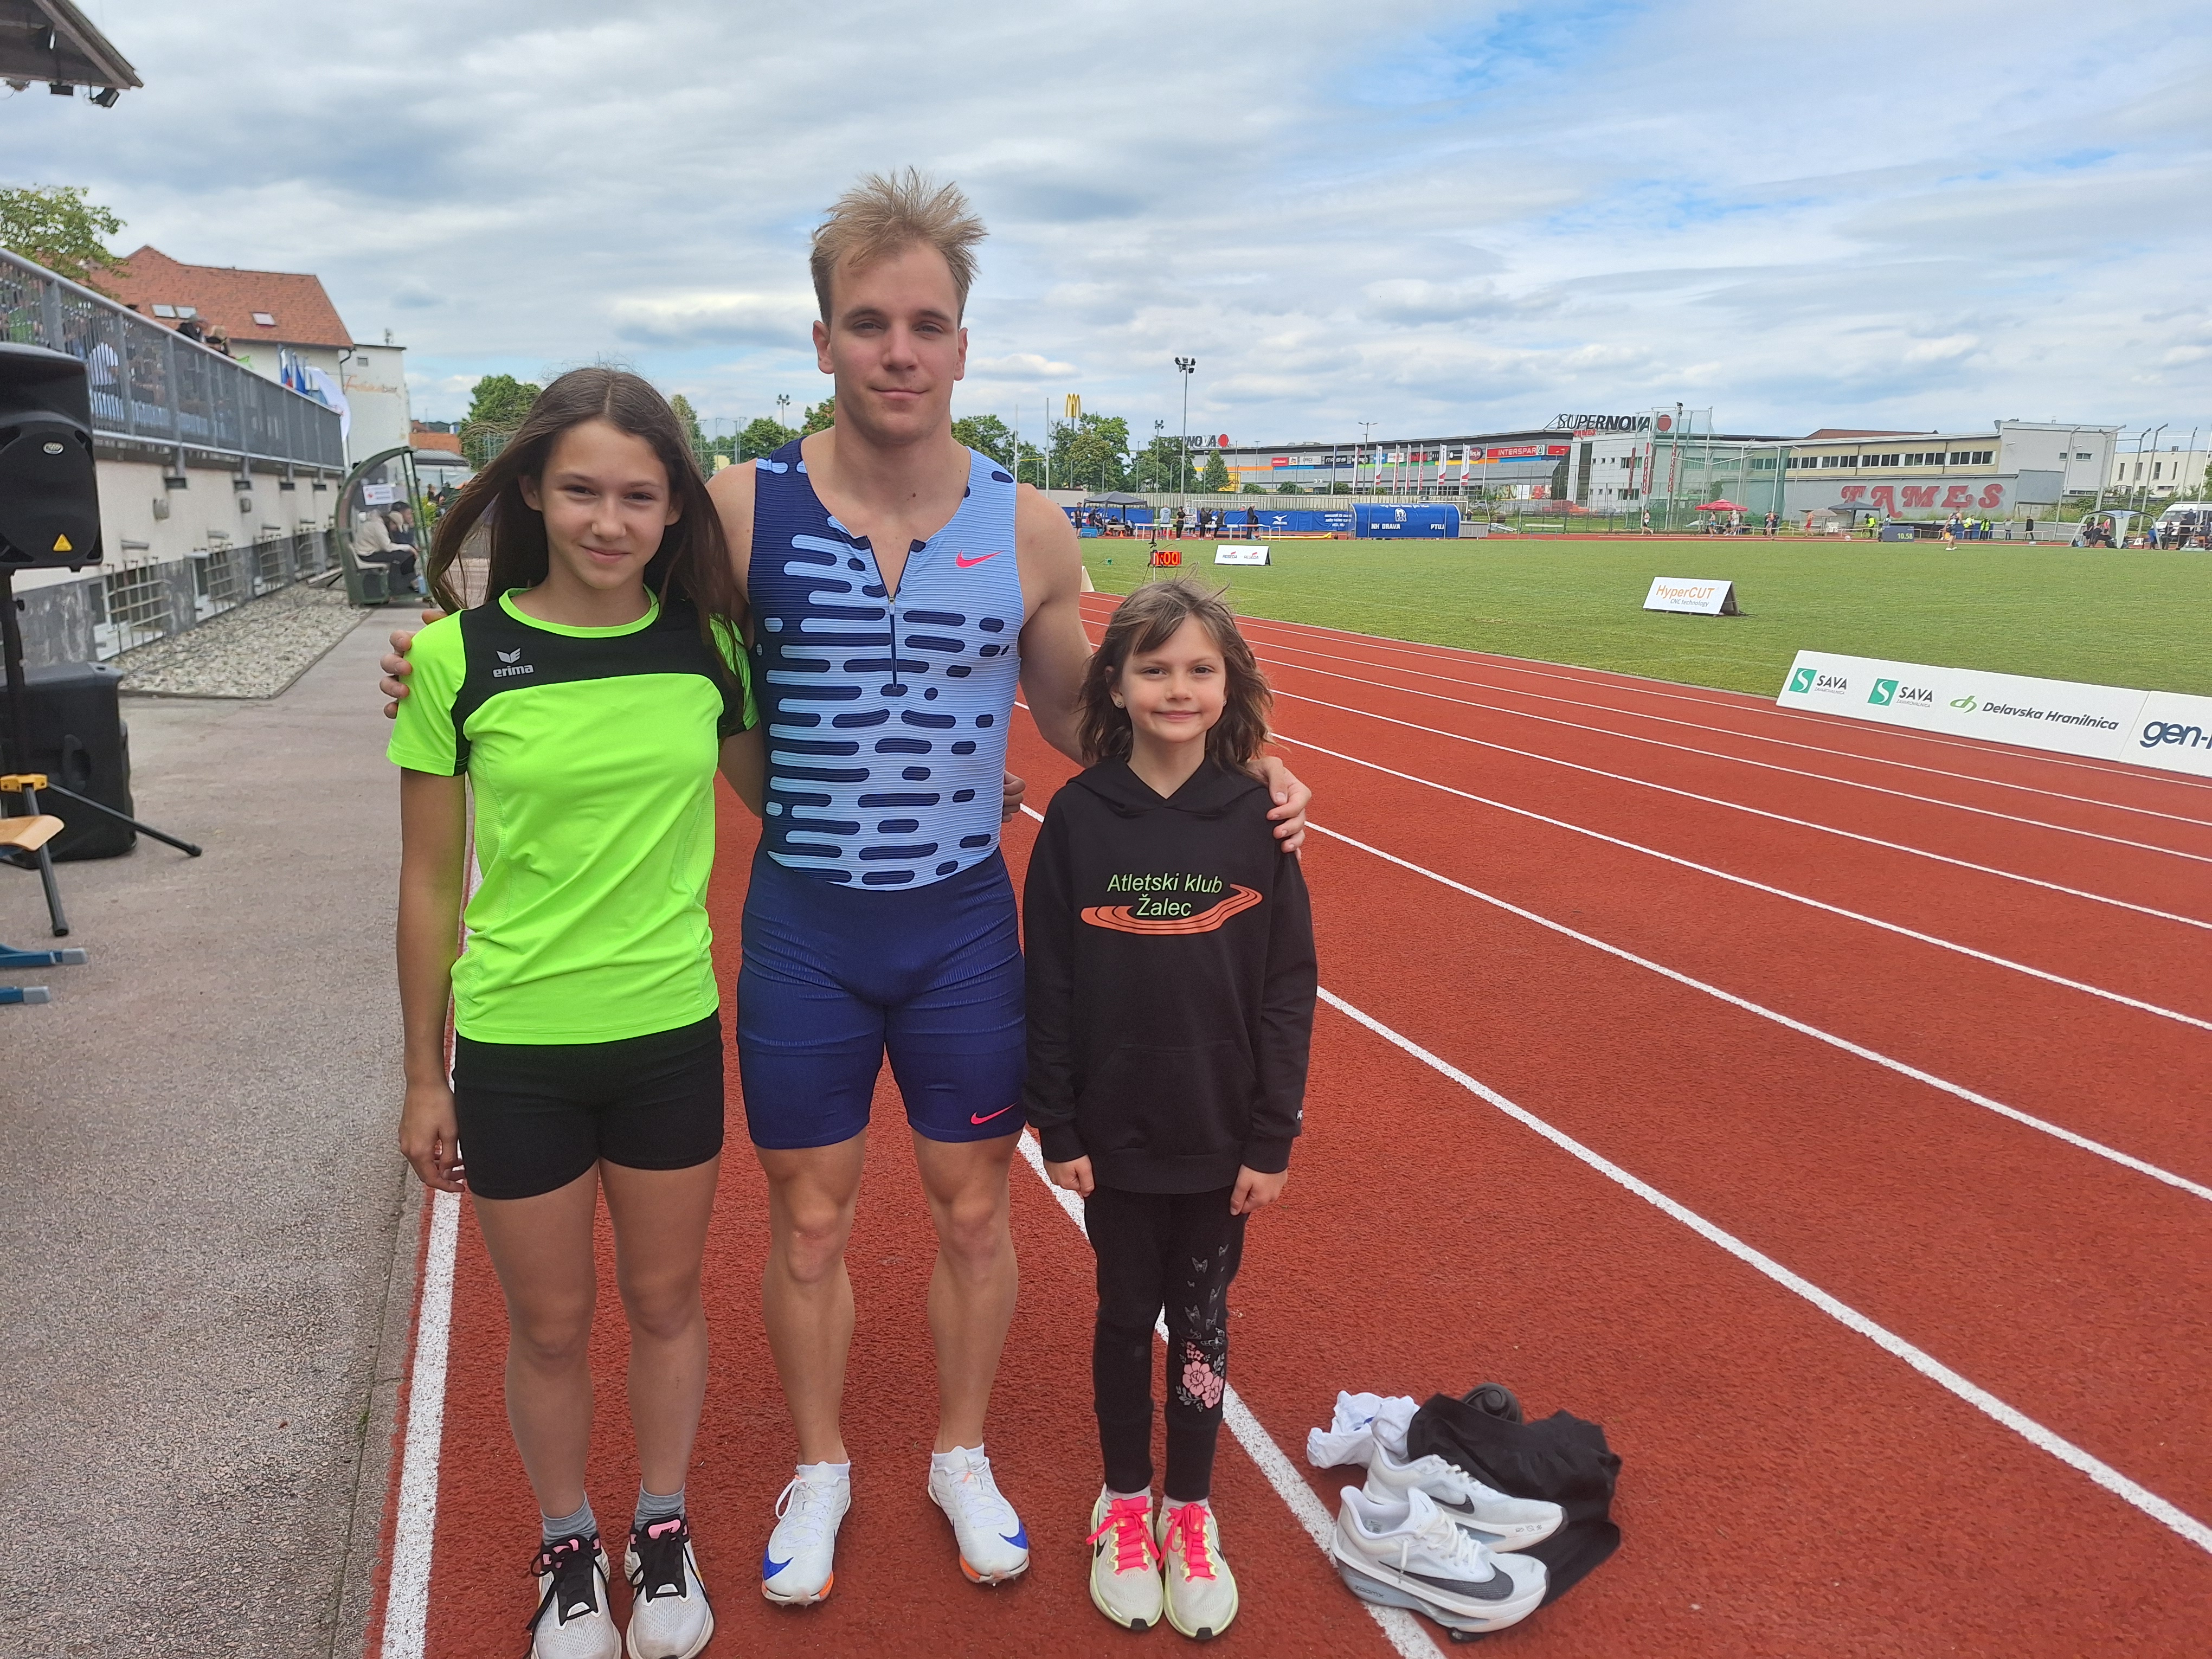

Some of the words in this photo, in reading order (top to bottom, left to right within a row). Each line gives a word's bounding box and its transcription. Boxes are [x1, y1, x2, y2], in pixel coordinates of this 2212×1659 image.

[1557, 414, 1652, 433] SUPERNOVA
[1498, 447, 1537, 456] INTERSPAR
[1841, 484, 2004, 518] TAMES
[1656, 584, 1715, 599] HyperCUT
[1681, 600, 1709, 608] technology
[493, 665, 534, 678] erima
[1817, 675, 1847, 690] SAVA
[1899, 686, 1933, 703] SAVA
[1982, 702, 2044, 719] Delavska
[2044, 710, 2119, 730] Hranilnica
[1107, 873, 1180, 892] Atletski
[1184, 873, 1223, 893] klub
[1136, 893, 1192, 916] Žalec
